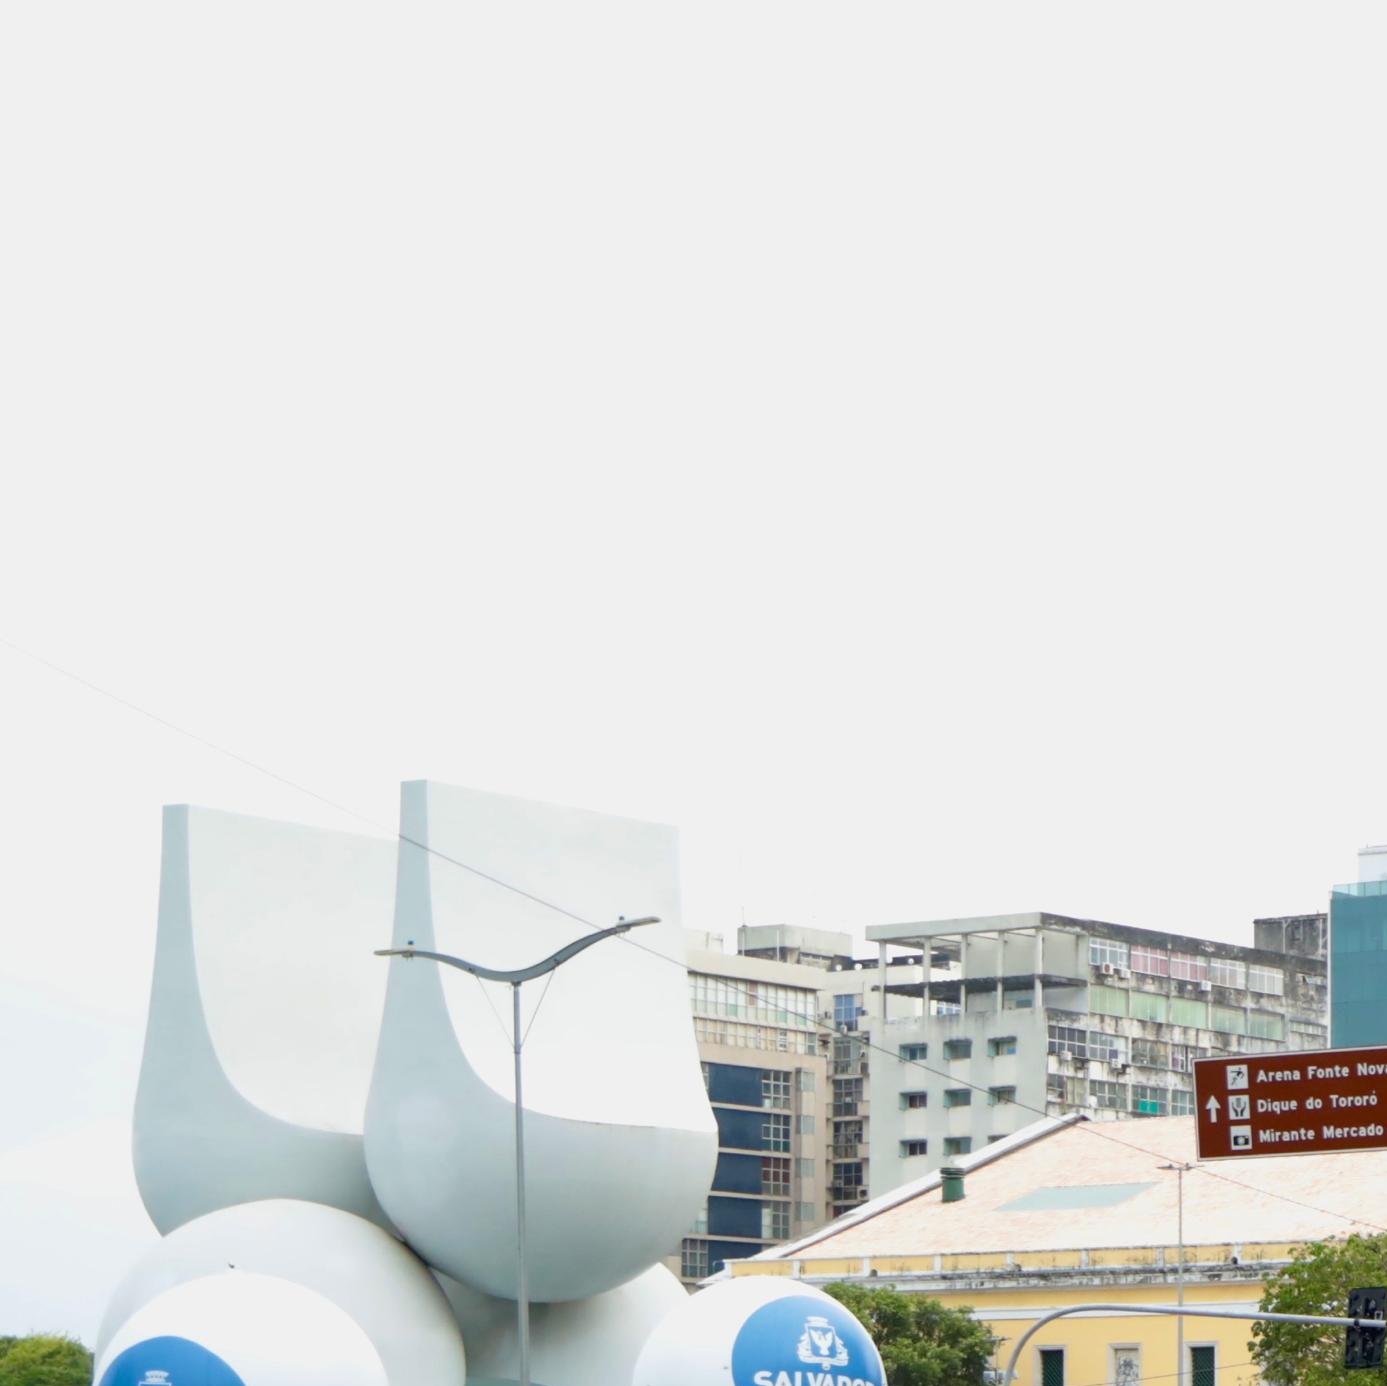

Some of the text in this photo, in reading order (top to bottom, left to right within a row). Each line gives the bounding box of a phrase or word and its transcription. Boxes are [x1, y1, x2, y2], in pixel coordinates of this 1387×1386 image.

[1257, 1069, 1300, 1083] Arena
[1308, 1065, 1349, 1080] Fonte
[1257, 1090, 1378, 1113] Dique do Tororó
[1259, 1127, 1315, 1143] Mirante
[1323, 1124, 1384, 1139] Mercado
